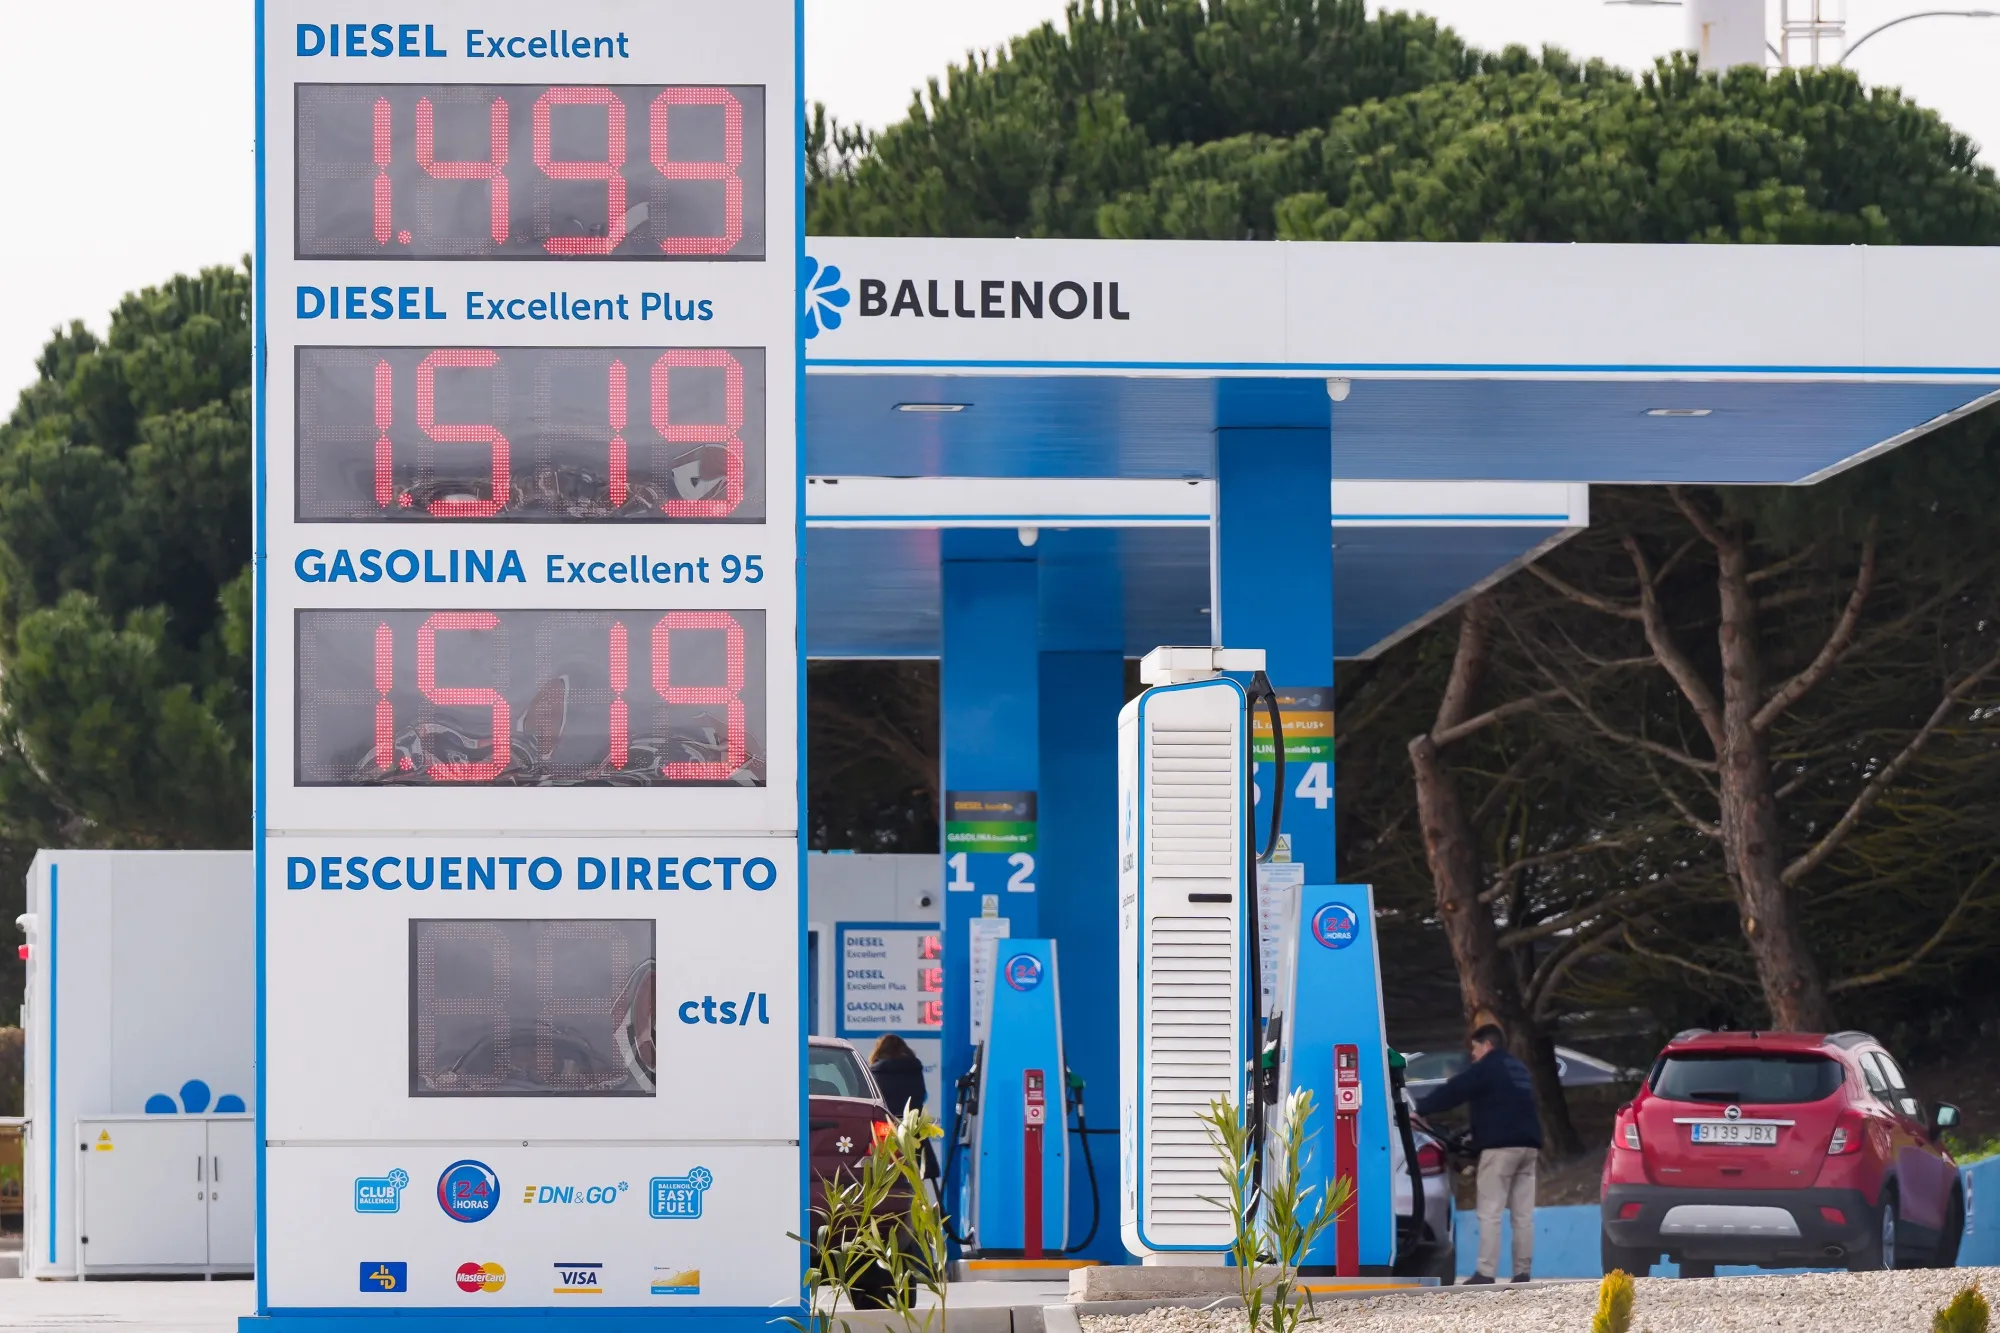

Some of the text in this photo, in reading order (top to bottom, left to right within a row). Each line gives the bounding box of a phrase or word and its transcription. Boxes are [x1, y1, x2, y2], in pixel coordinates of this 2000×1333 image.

[296, 23, 630, 59] DIESEL Excellent
[373, 88, 743, 255] 1.499
[296, 286, 713, 321] DIESEL Excellent Plus
[859, 278, 1130, 321] BALLENOIL
[374, 349, 744, 518] 1.519
[294, 549, 764, 584] GASOLINA Excellent 95
[374, 611, 747, 782] 1.519
[1295, 762, 1333, 809] 4
[286, 855, 778, 892] DESCUENTO DIRECTO
[947, 852, 975, 892] 1
[1007, 852, 1035, 892] 2
[1327, 917, 1350, 931] 24
[847, 937, 884, 946] DIESEL
[847, 949, 886, 958] Excellent
[847, 969, 884, 979] DIESEL
[847, 982, 906, 991] Excellent Plus
[678, 992, 770, 1026] cts/l
[847, 1001, 904, 1011] GASOLINA
[847, 1014, 886, 1023] Excellent
[1701, 1125, 1773, 1140] 9139 JBX
[359, 1186, 395, 1198] CLUB
[457, 1181, 488, 1198] 24
[538, 1186, 617, 1204] DNI&GO
[658, 1190, 694, 1201] EASY
[457, 1200, 489, 1209] HORAS
[658, 1202, 694, 1213] FUEL
[456, 1272, 505, 1283] MasterCard
[559, 1271, 597, 1285] VISA
